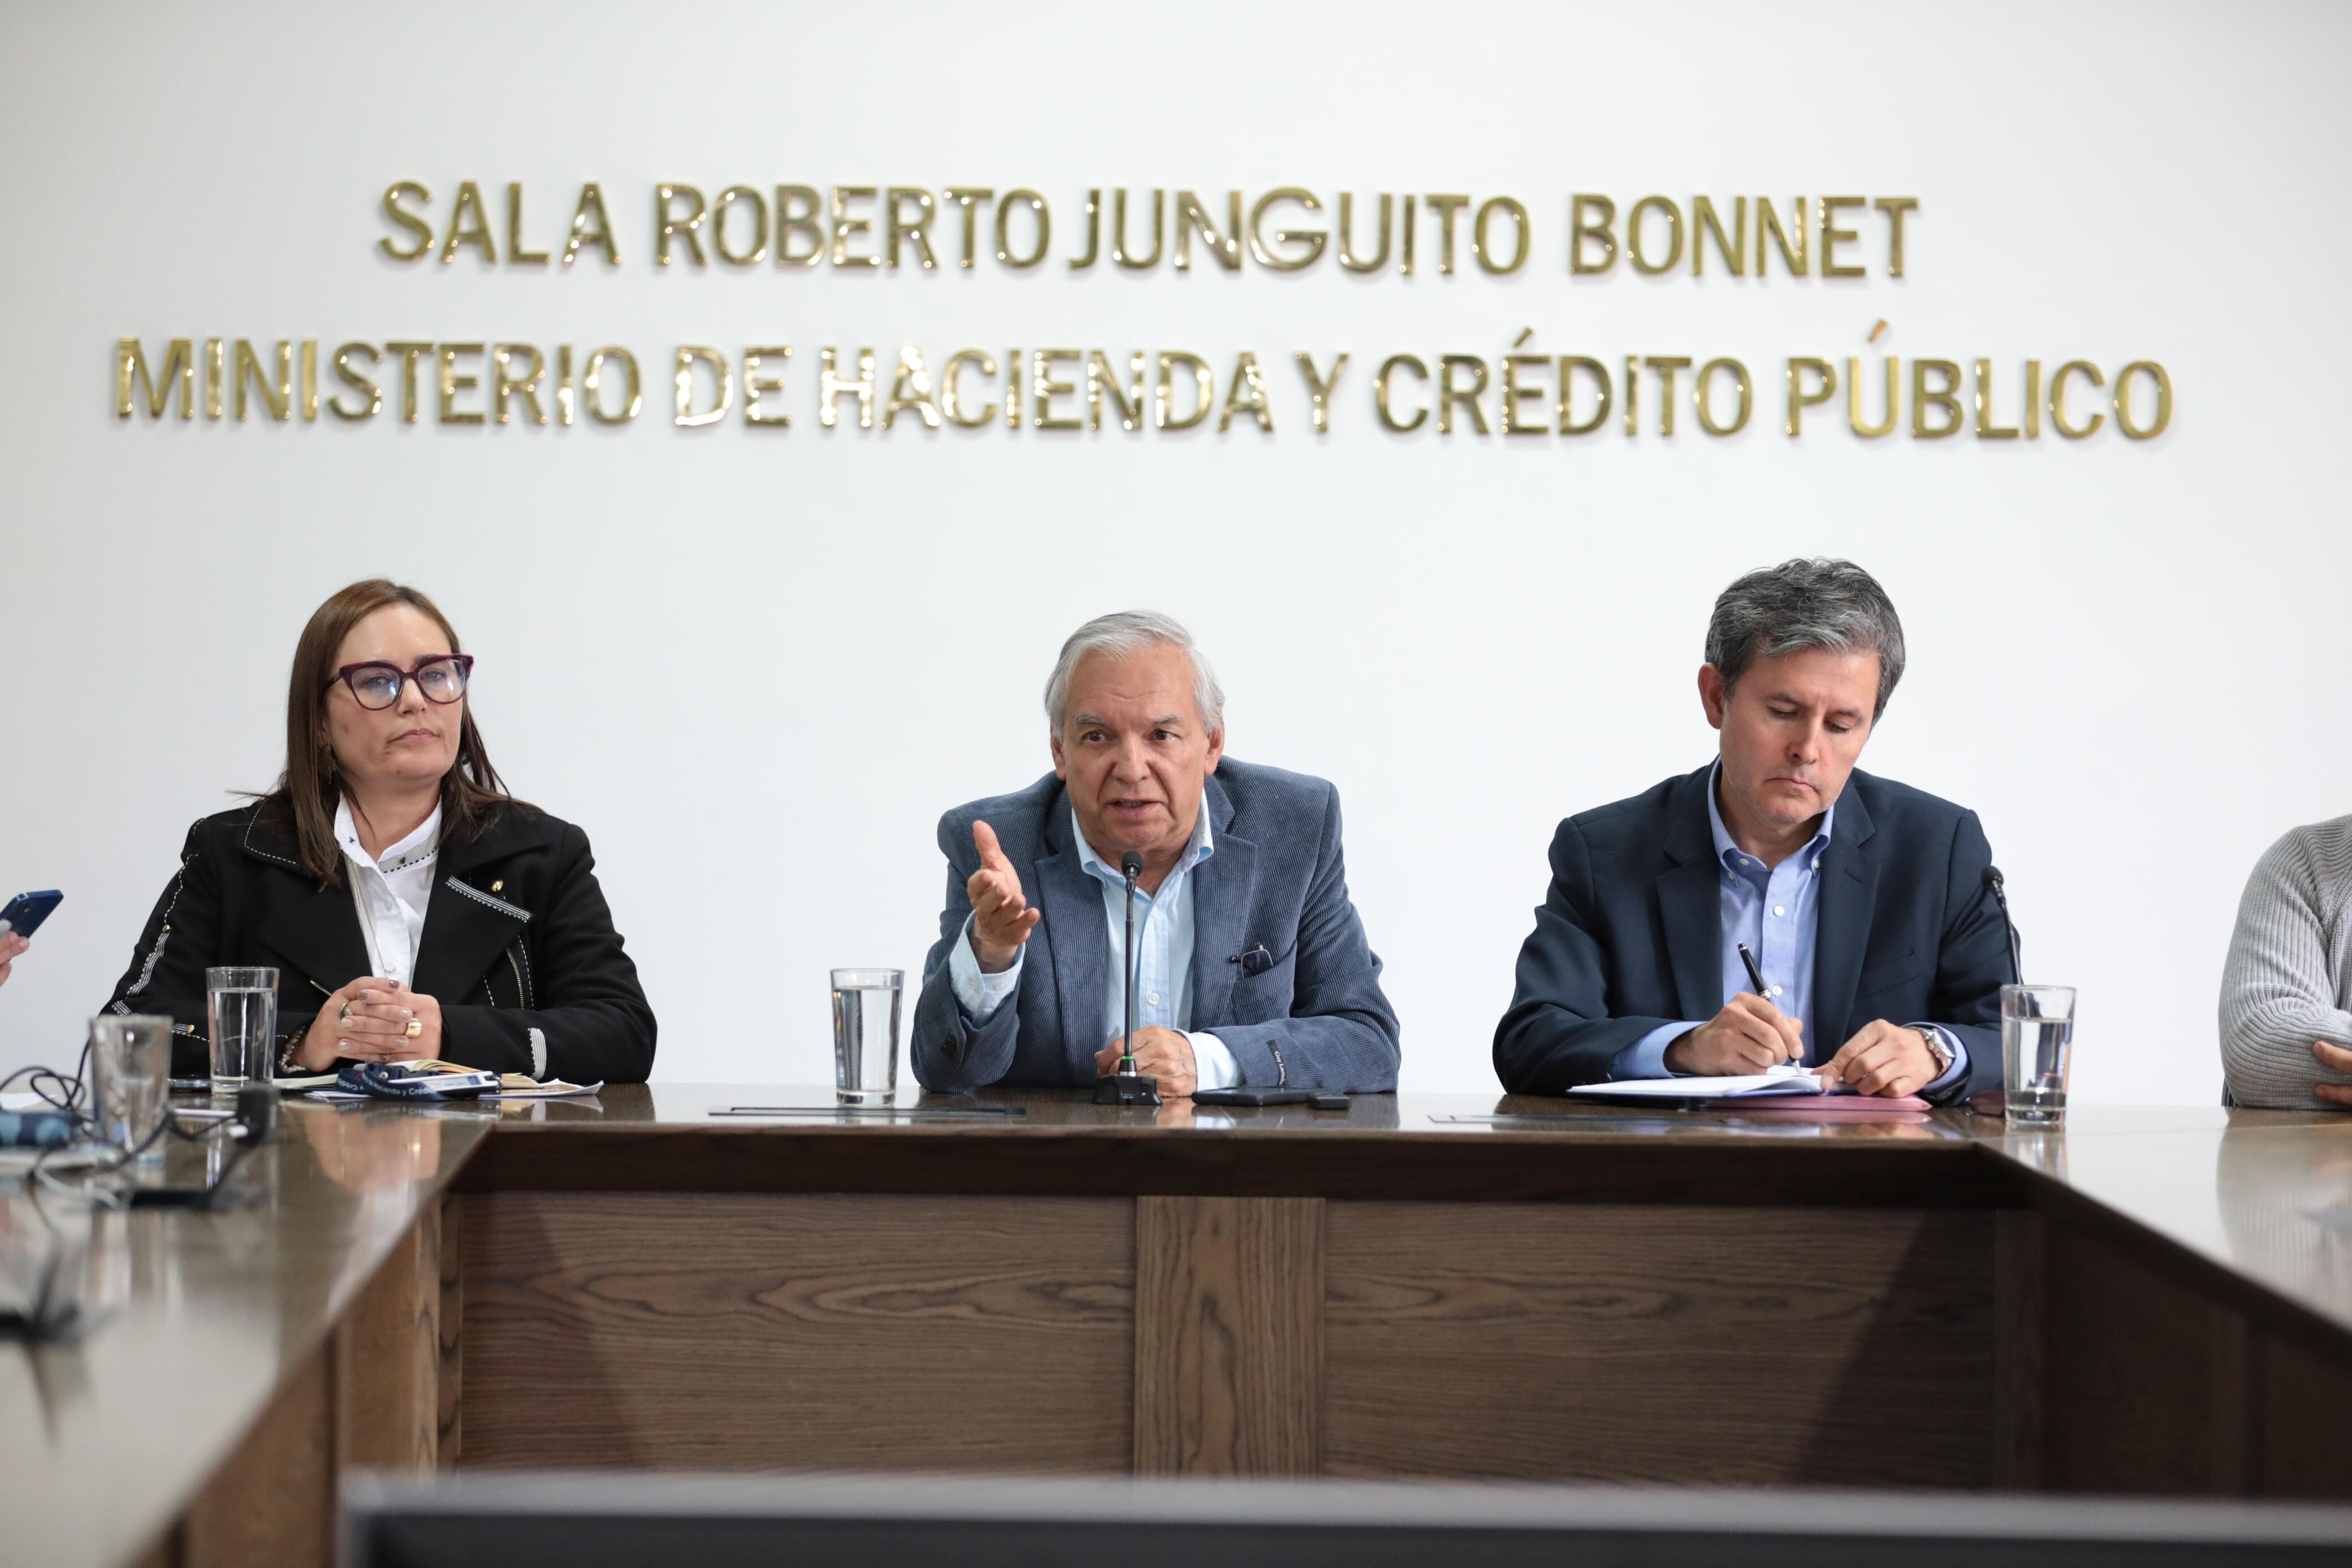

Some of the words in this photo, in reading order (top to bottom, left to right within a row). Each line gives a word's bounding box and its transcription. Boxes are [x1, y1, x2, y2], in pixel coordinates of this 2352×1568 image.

[379, 181, 620, 266] SALA
[656, 184, 1050, 268] ROBERTO
[1069, 188, 1530, 275] JUNGUITO
[1571, 195, 1918, 277] BONNET
[117, 338, 640, 426] MINISTERIO
[677, 346, 790, 428] DE
[823, 348, 1272, 431] HACIENDA
[1297, 353, 1348, 432] Y
[1376, 328, 1752, 436] CRÉDITO
[1788, 320, 2173, 439] PÚBLICO
